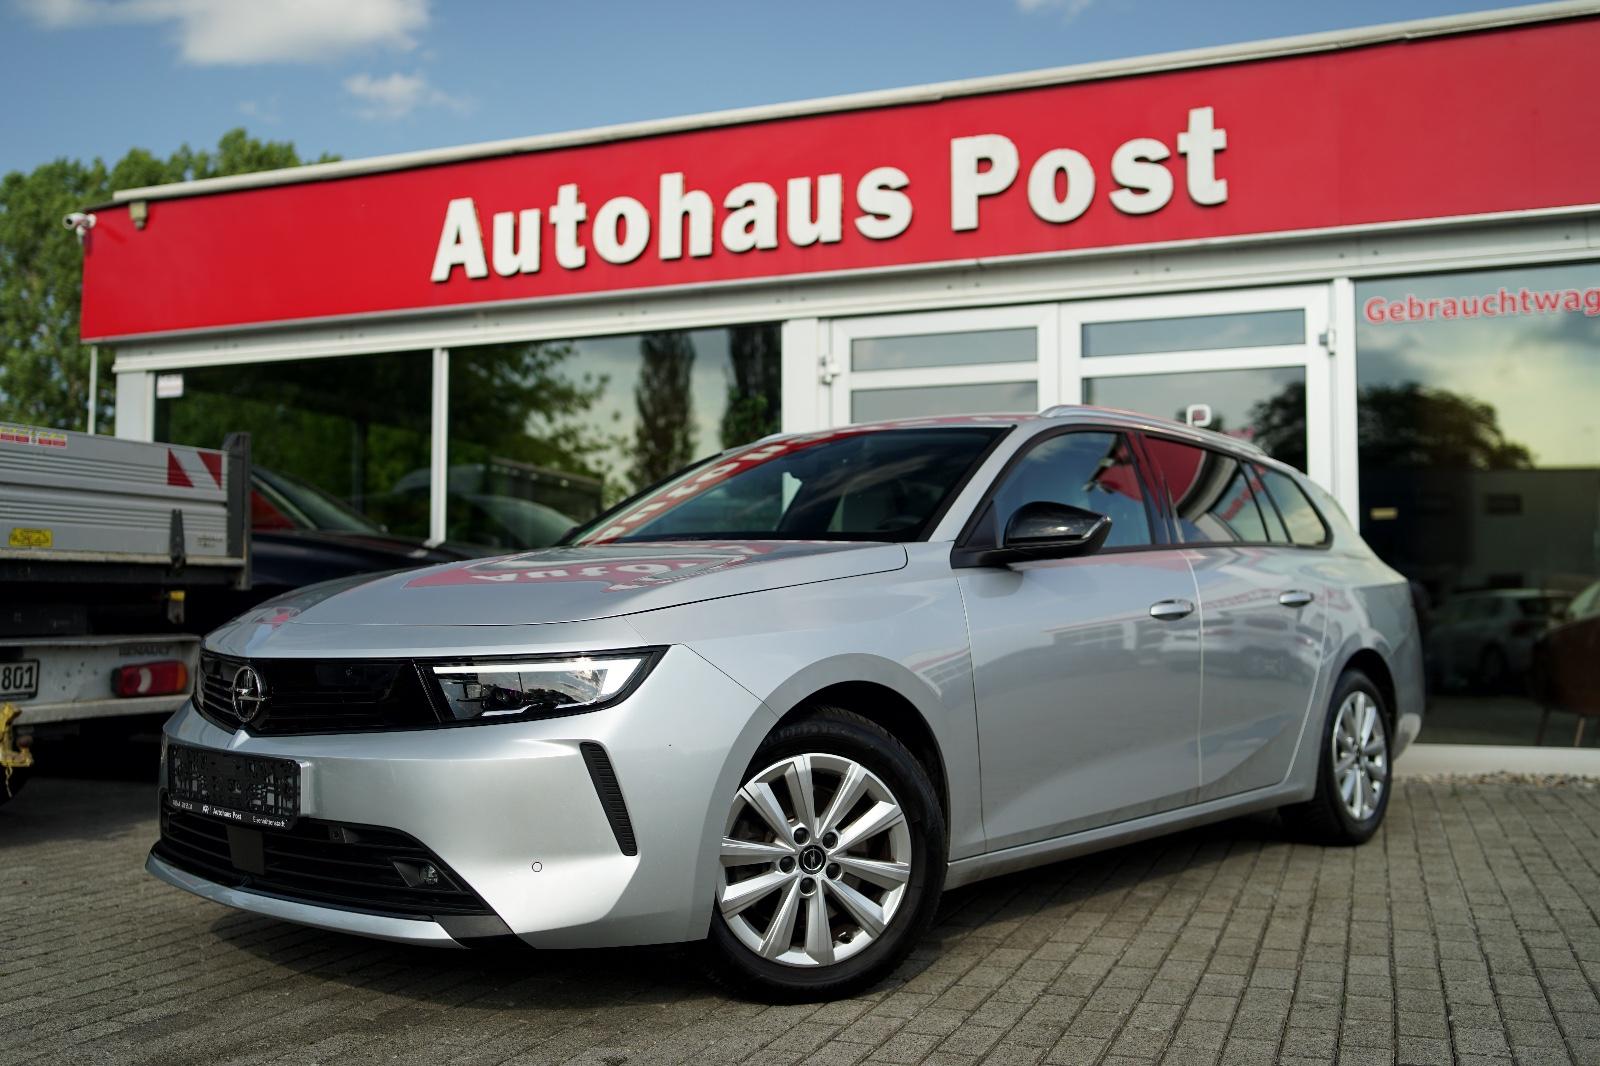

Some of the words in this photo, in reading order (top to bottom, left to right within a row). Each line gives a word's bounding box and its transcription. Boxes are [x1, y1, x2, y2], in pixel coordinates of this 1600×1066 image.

[430, 166, 914, 284] Autohaus
[950, 106, 1229, 232] Post
[1364, 288, 1600, 323] Gebrauchtwag
[2, 665, 34, 691] 801
